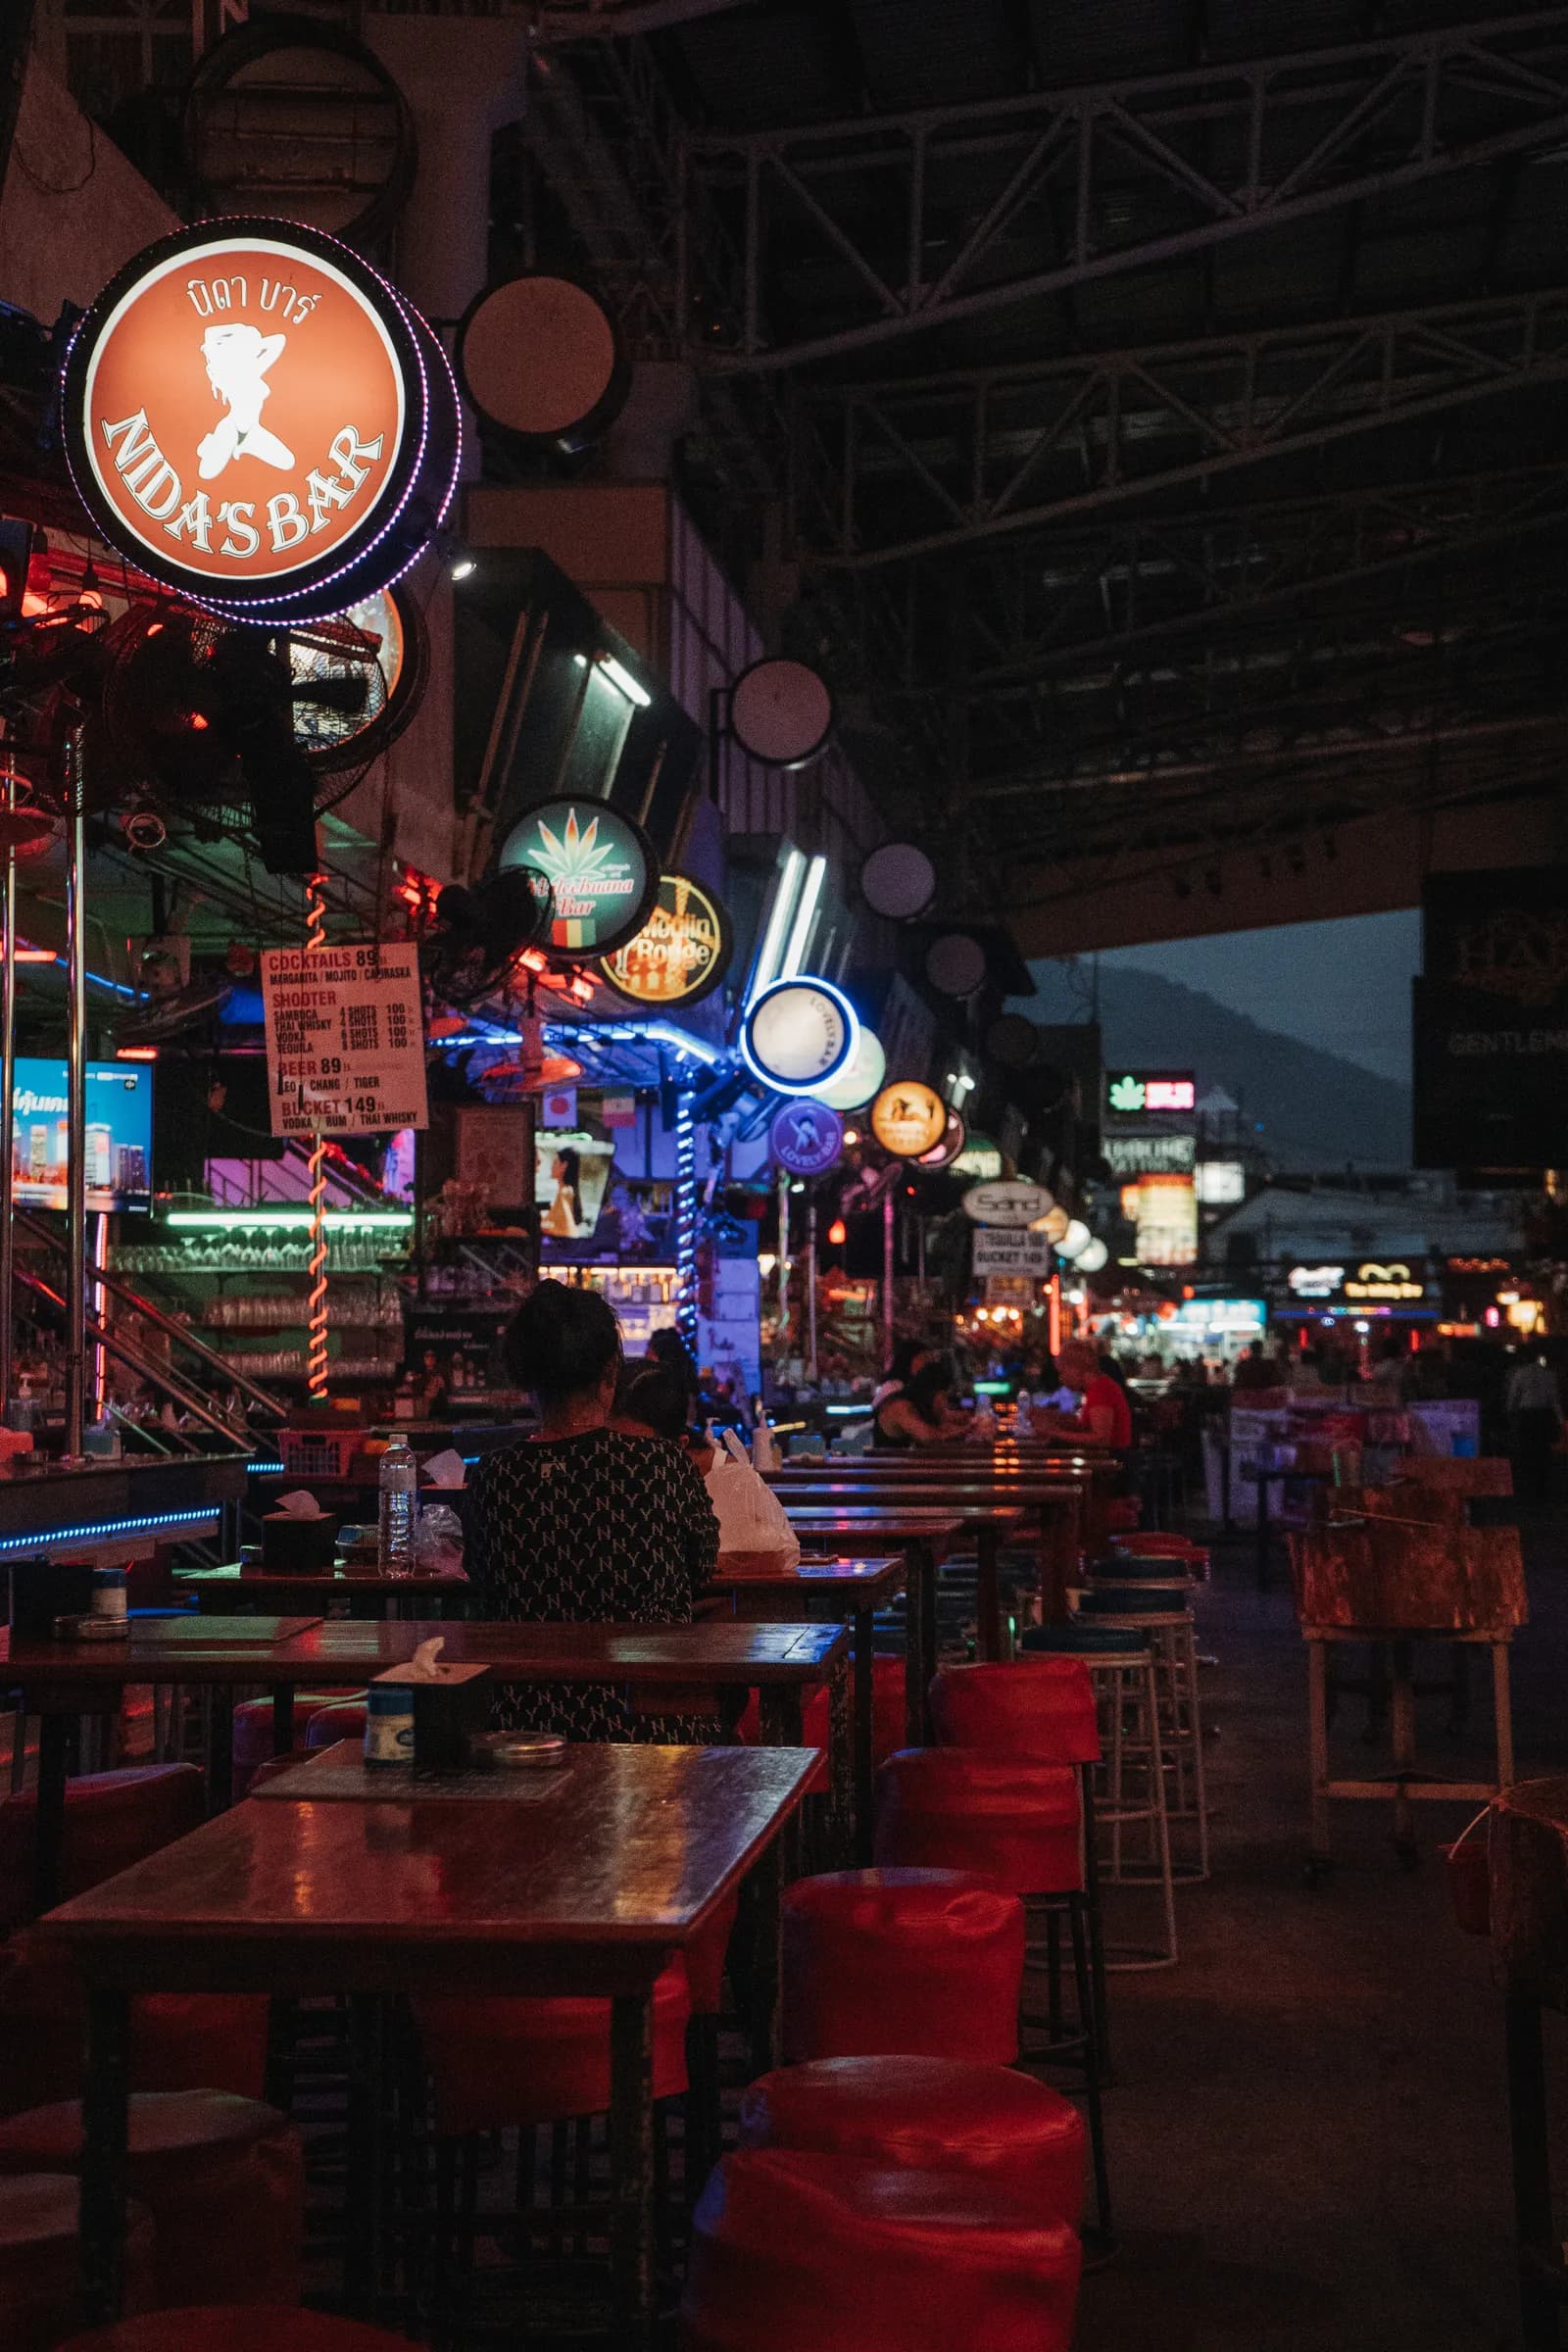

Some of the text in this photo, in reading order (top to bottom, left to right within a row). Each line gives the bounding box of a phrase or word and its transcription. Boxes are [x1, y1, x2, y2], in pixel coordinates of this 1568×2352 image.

[186, 275, 323, 325] นิดา บาร์
[100, 408, 384, 558] NIDA'S BAR
[269, 950, 379, 971] COCKTAILS 89
[270, 971, 318, 986] MARGARITA
[325, 969, 357, 982] MOJITO
[272, 991, 337, 1007] SHOOTER
[348, 1005, 377, 1016] SHOTS
[386, 1004, 405, 1014] 100
[274, 1020, 296, 1032] THAI
[298, 1019, 331, 1030] WHISKY
[348, 1015, 377, 1027] SHOTS
[387, 1015, 406, 1025] 100
[275, 1031, 306, 1043] VODKA
[350, 1027, 378, 1039] SHOTS
[388, 1026, 407, 1037] 100
[351, 1038, 379, 1051] SHOTS
[388, 1038, 407, 1049] 100
[277, 1060, 317, 1076] BEER
[320, 1058, 341, 1074] 89
[310, 1077, 340, 1091] CHANG
[354, 1076, 380, 1089] TIGER
[281, 1097, 375, 1116] BUCKET 149
[282, 1117, 313, 1129] VODKA
[325, 1114, 347, 1127] RUM
[361, 1113, 381, 1124] THAI
[383, 1111, 417, 1124] WHISKY
